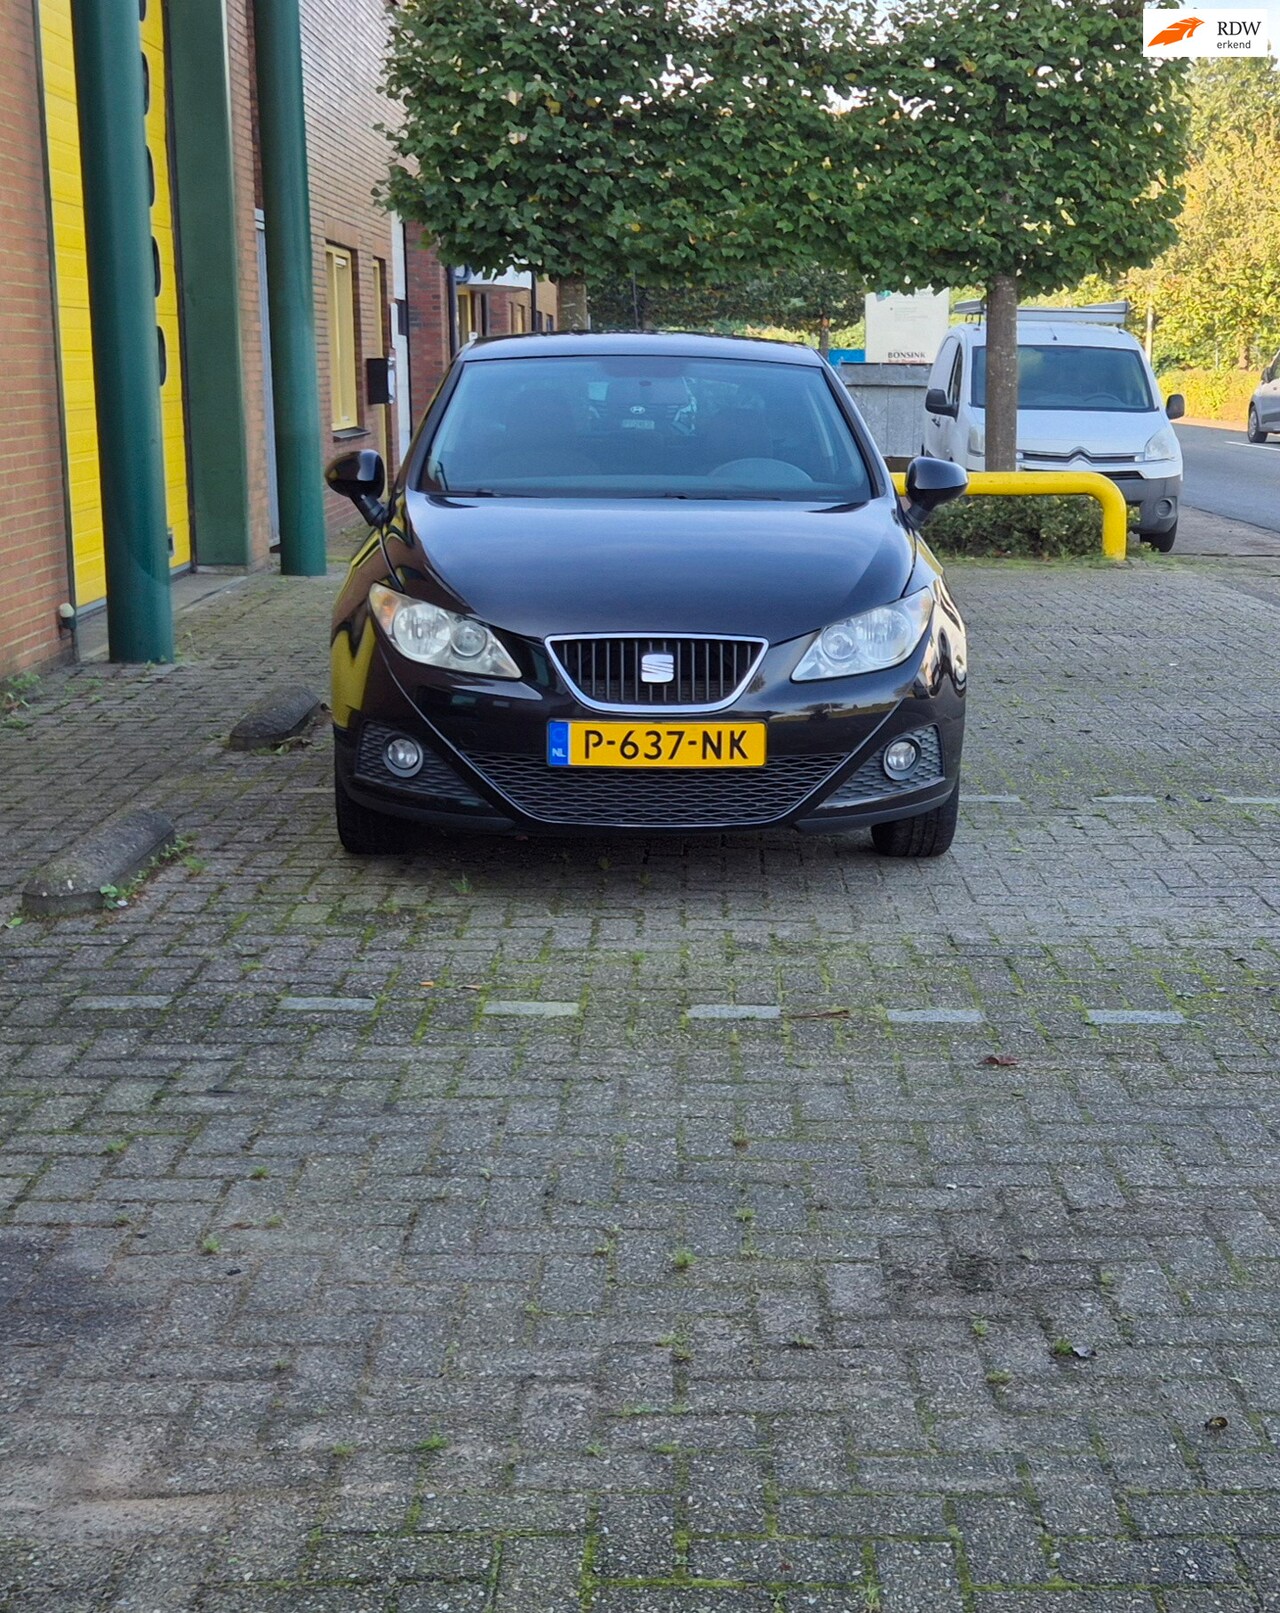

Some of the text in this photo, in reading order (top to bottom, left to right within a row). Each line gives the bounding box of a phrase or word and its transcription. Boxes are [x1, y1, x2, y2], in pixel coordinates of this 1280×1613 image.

[887, 351, 926, 359] BONSINK
[584, 729, 749, 760] P-637-NK
[551, 747, 566, 758] NL
